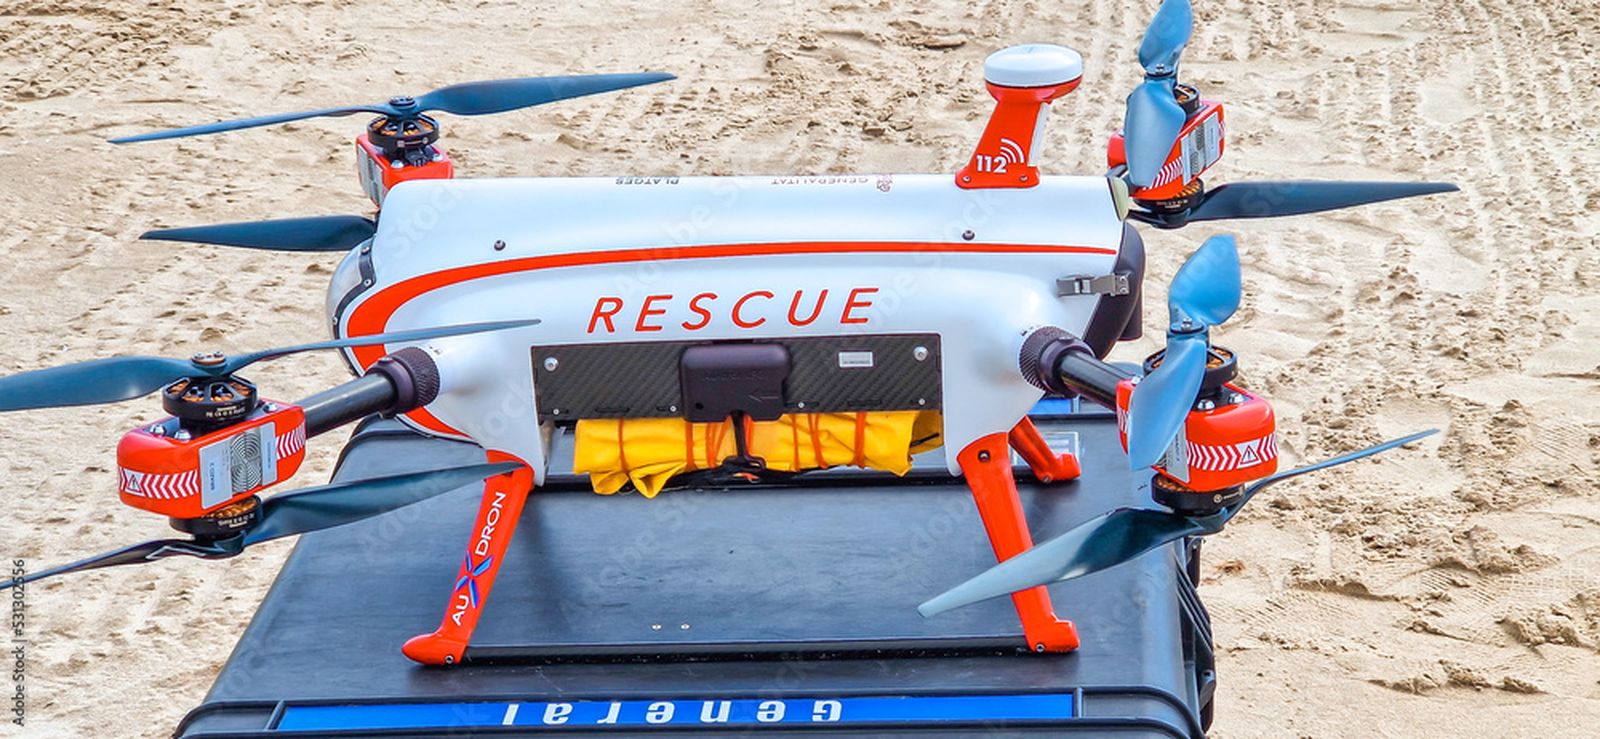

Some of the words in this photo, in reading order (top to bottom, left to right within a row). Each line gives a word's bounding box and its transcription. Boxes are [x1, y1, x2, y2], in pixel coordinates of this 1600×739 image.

[976, 154, 1007, 174] 112
[587, 287, 879, 334] RESCUE
[501, 699, 842, 726] General
